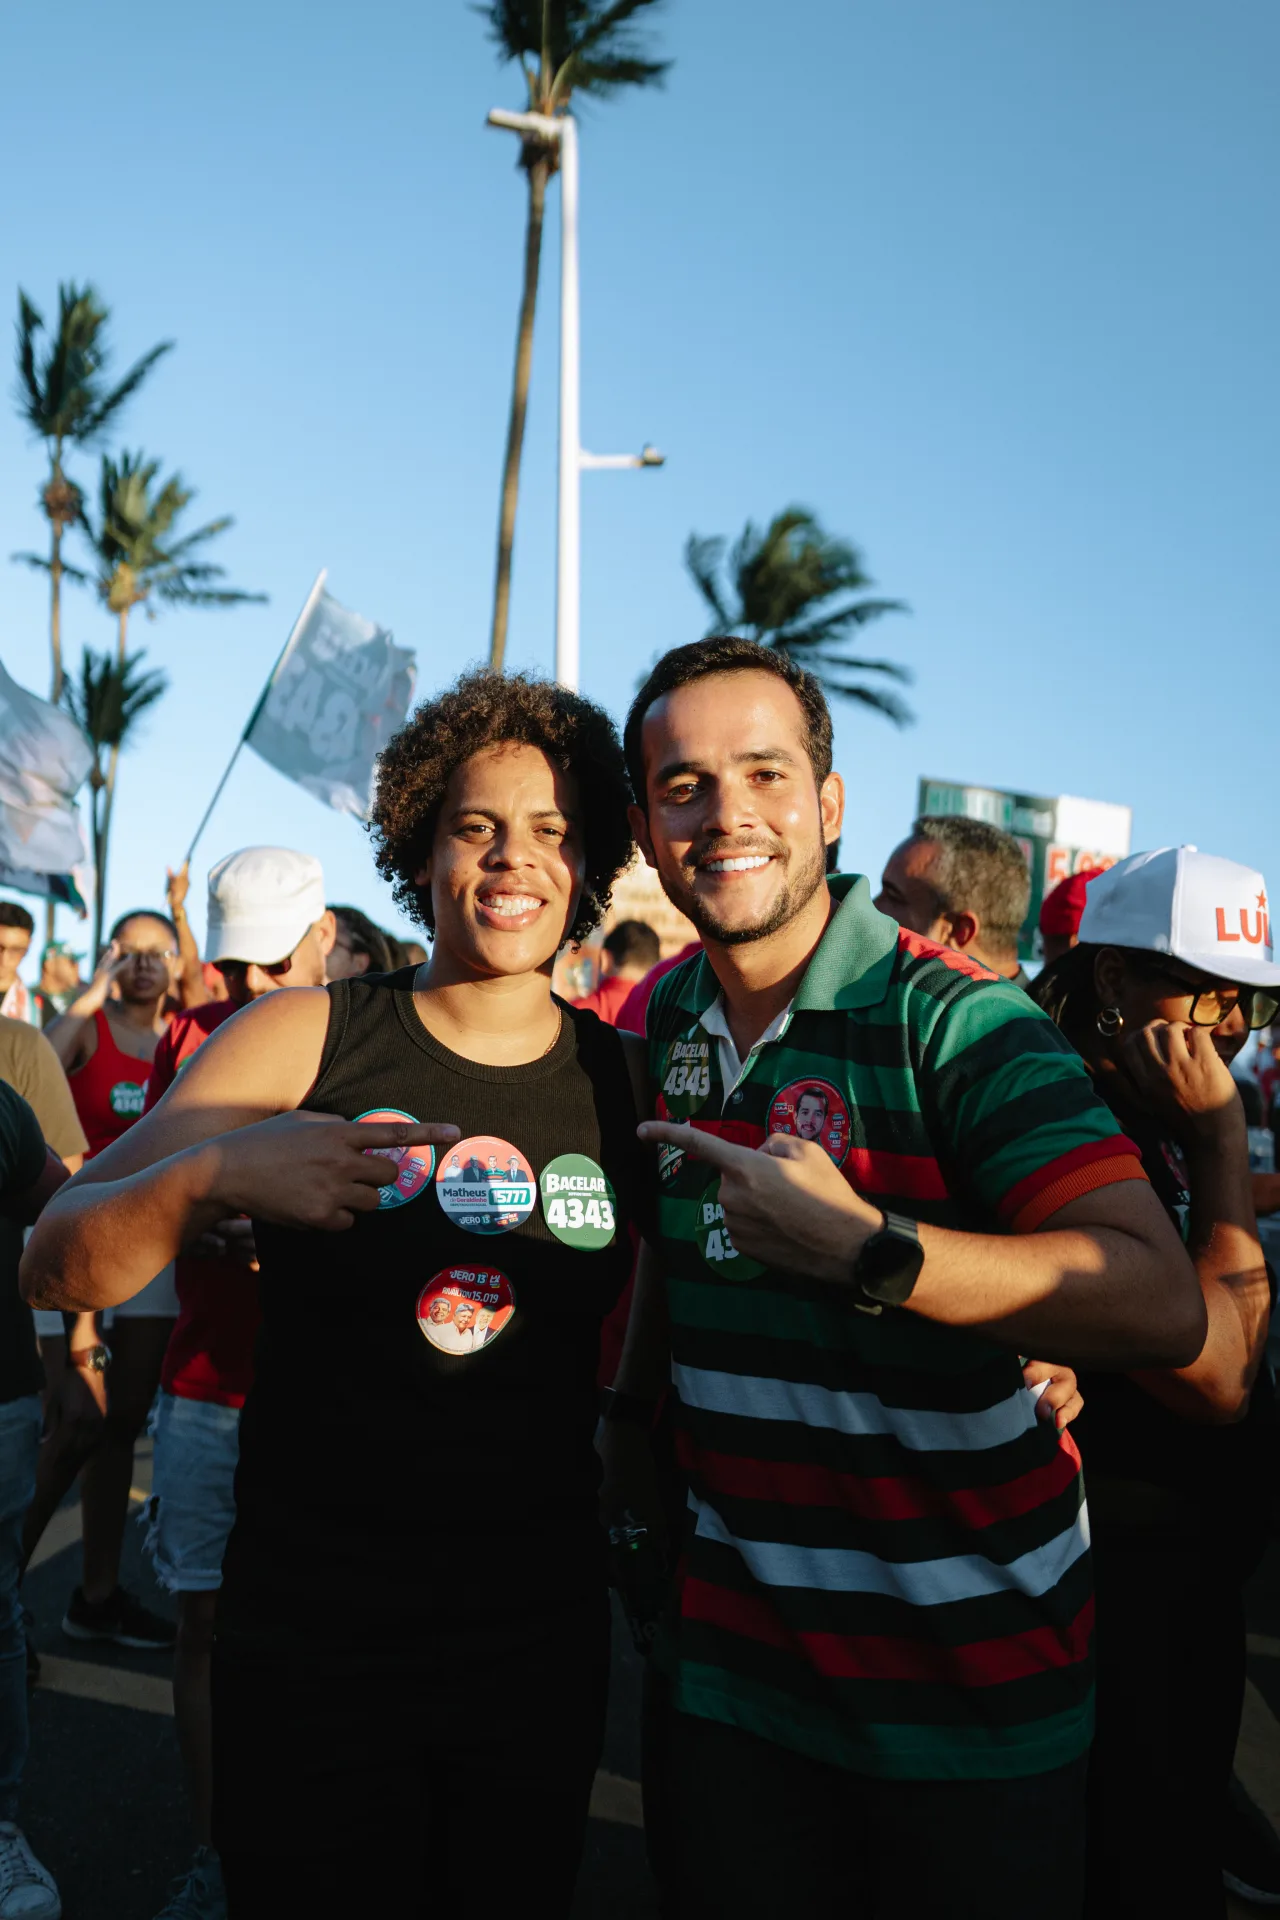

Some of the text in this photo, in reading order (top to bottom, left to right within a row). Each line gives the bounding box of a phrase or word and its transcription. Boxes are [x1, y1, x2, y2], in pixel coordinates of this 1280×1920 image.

[663, 1065, 710, 1096] 4343
[546, 1173, 606, 1193] BACELAR
[442, 1187, 487, 1197] Matheus
[491, 1189, 528, 1204] 15777
[459, 1216, 481, 1224] JERO
[481, 1216, 490, 1224] 13
[547, 1198, 615, 1230] 4343
[449, 1269, 475, 1282] JERO
[477, 1273, 487, 1284] 13
[472, 1290, 500, 1303] 15.019
